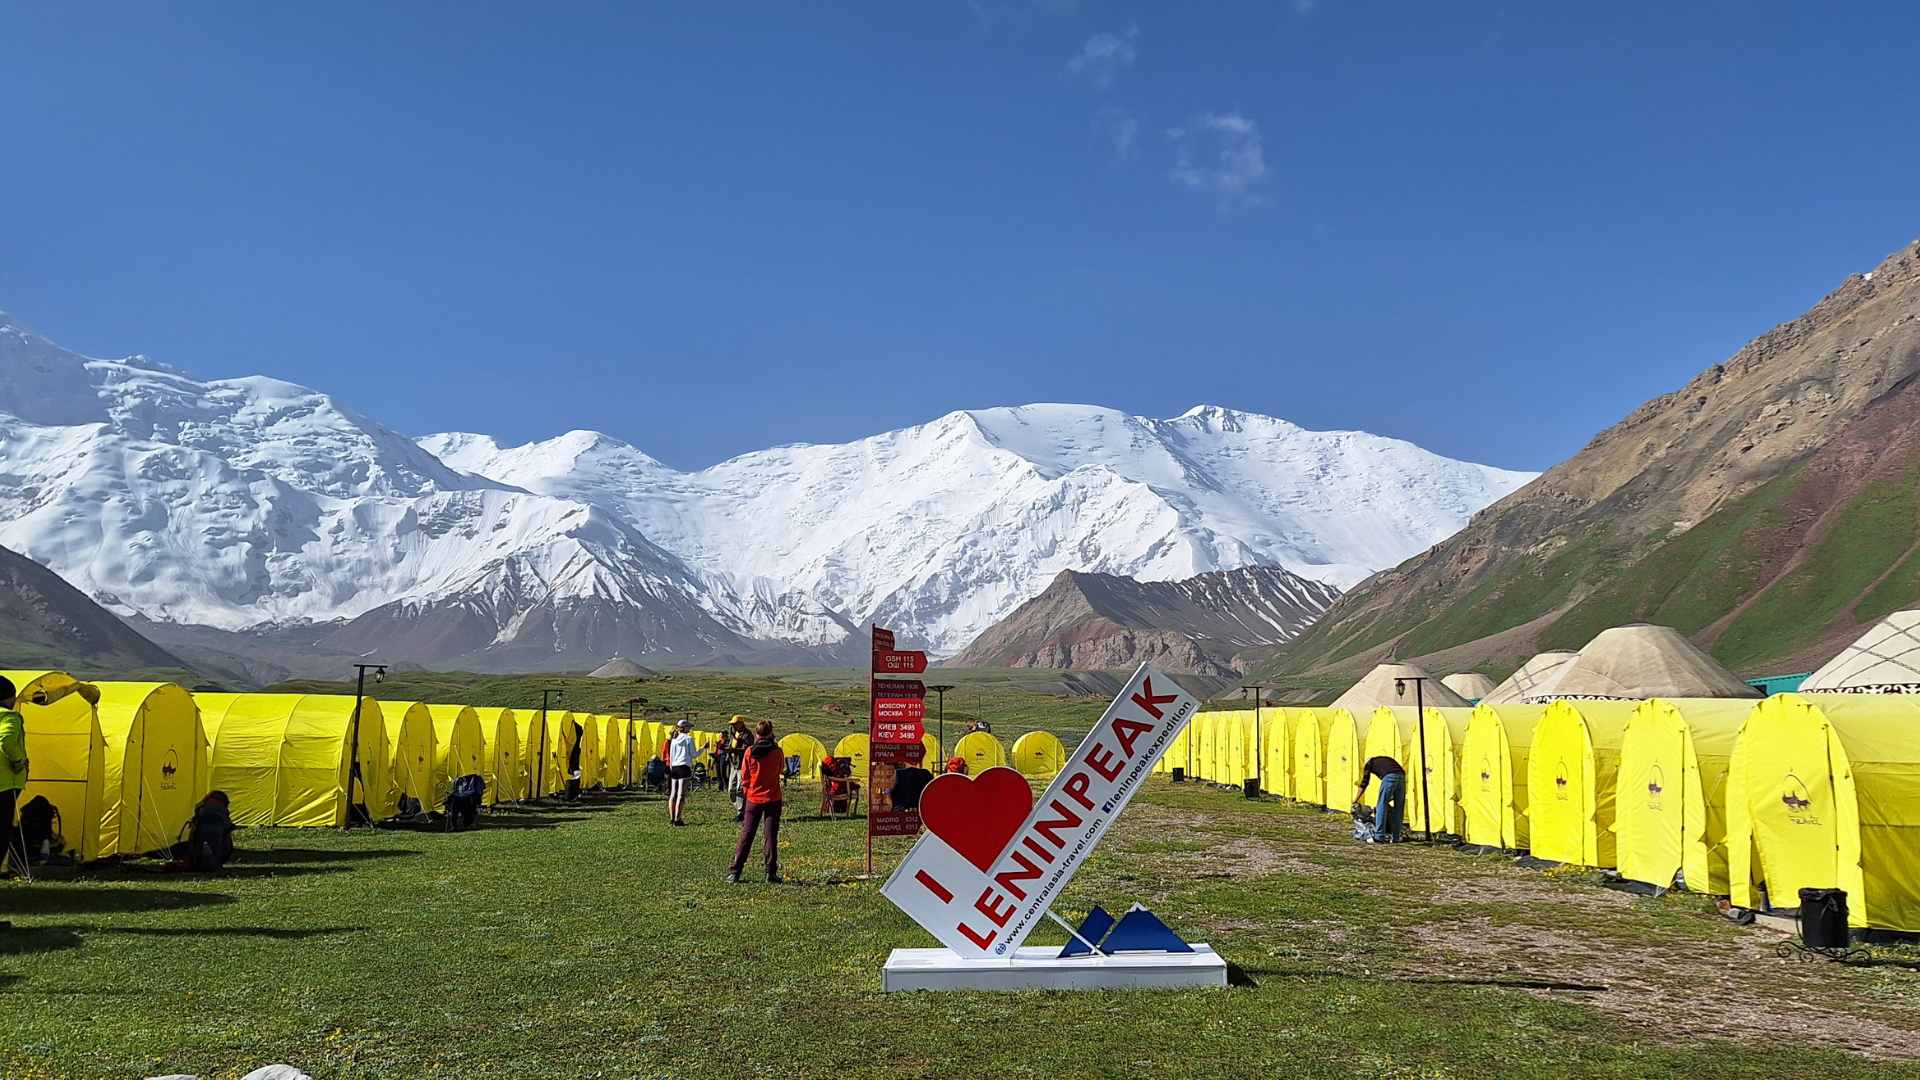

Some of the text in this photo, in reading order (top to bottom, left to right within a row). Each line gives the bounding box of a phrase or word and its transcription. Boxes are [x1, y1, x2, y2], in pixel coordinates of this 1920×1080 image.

[878, 723, 897, 731] КИЕВ
[878, 731, 896, 739] KIEV
[1109, 701, 1191, 805] leninpeakexpedition
[956, 674, 1179, 951] LENINPEAK
[914, 868, 955, 905] I
[1004, 817, 1102, 945] www.centralasia-travel.com
